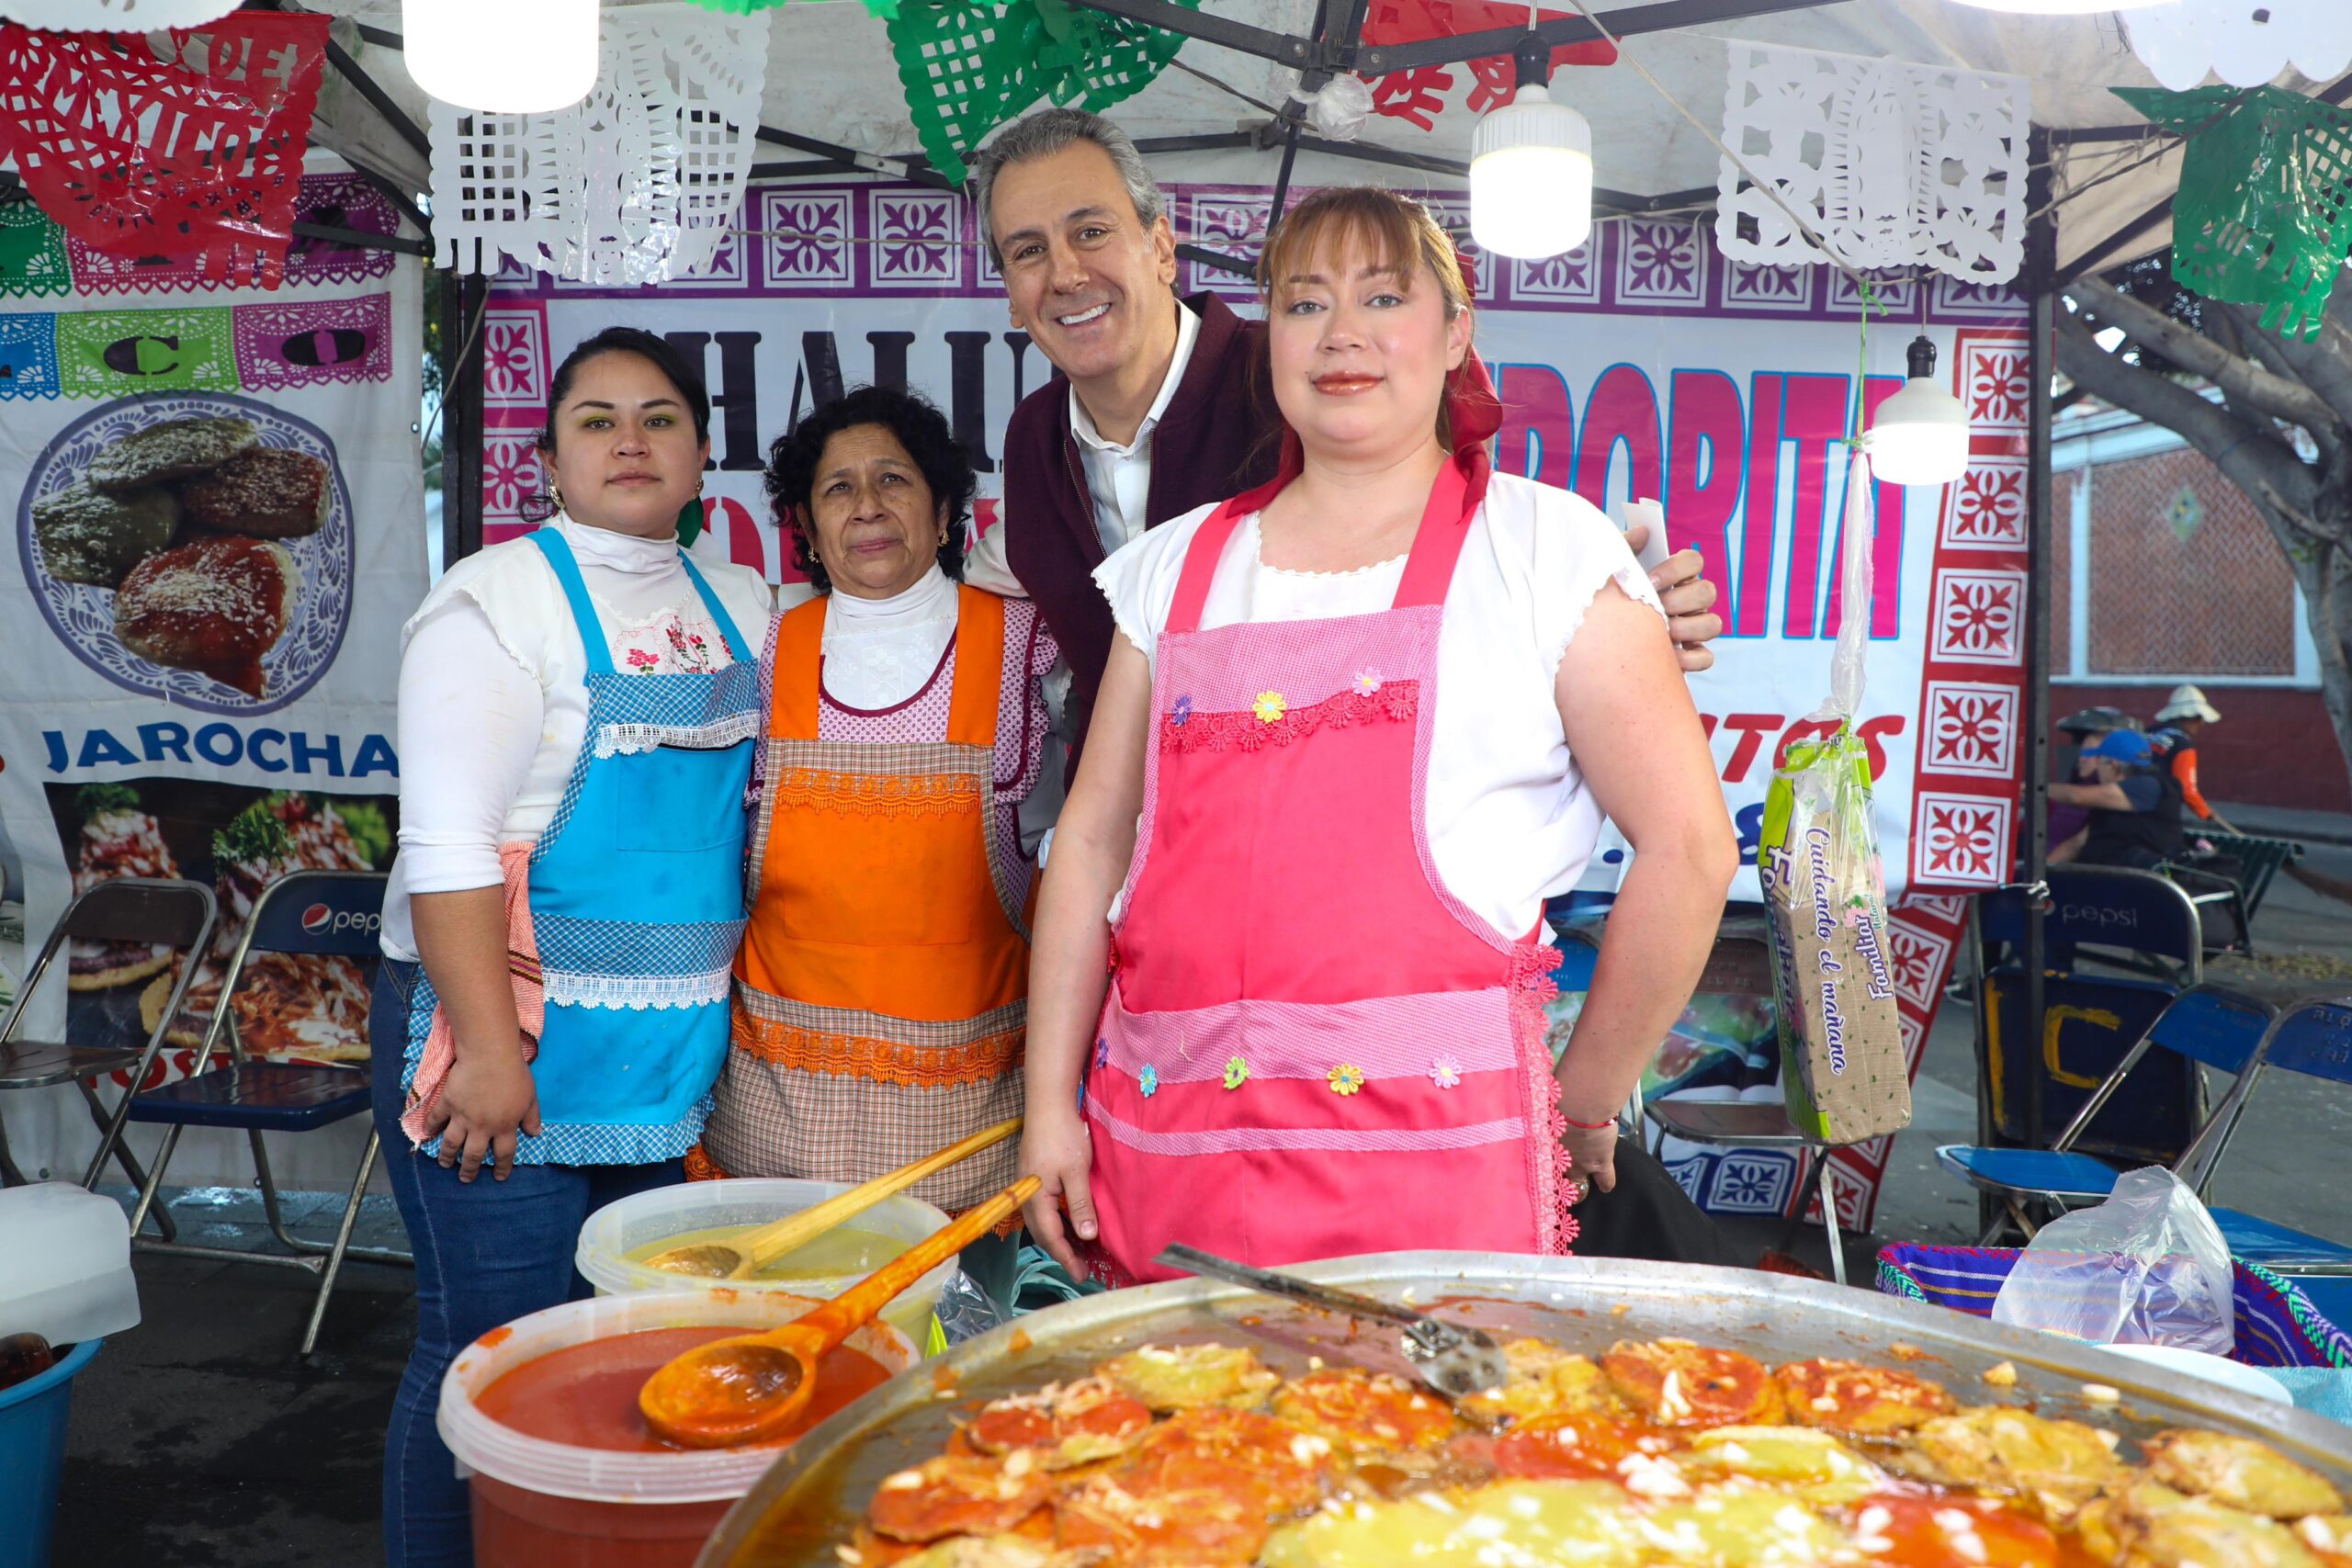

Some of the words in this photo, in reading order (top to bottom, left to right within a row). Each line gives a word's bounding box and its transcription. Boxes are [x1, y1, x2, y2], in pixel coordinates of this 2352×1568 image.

[42, 721, 399, 778] JAROCHA
[1806, 828, 1837, 943] Cuidando
[1865, 893, 1882, 931] Natural
[2063, 904, 2137, 928] pepsi
[1761, 844, 1796, 1014] Failiar
[1818, 950, 1842, 975] el
[1855, 915, 1894, 1000] Familiar
[1822, 981, 1847, 1075] mañana
